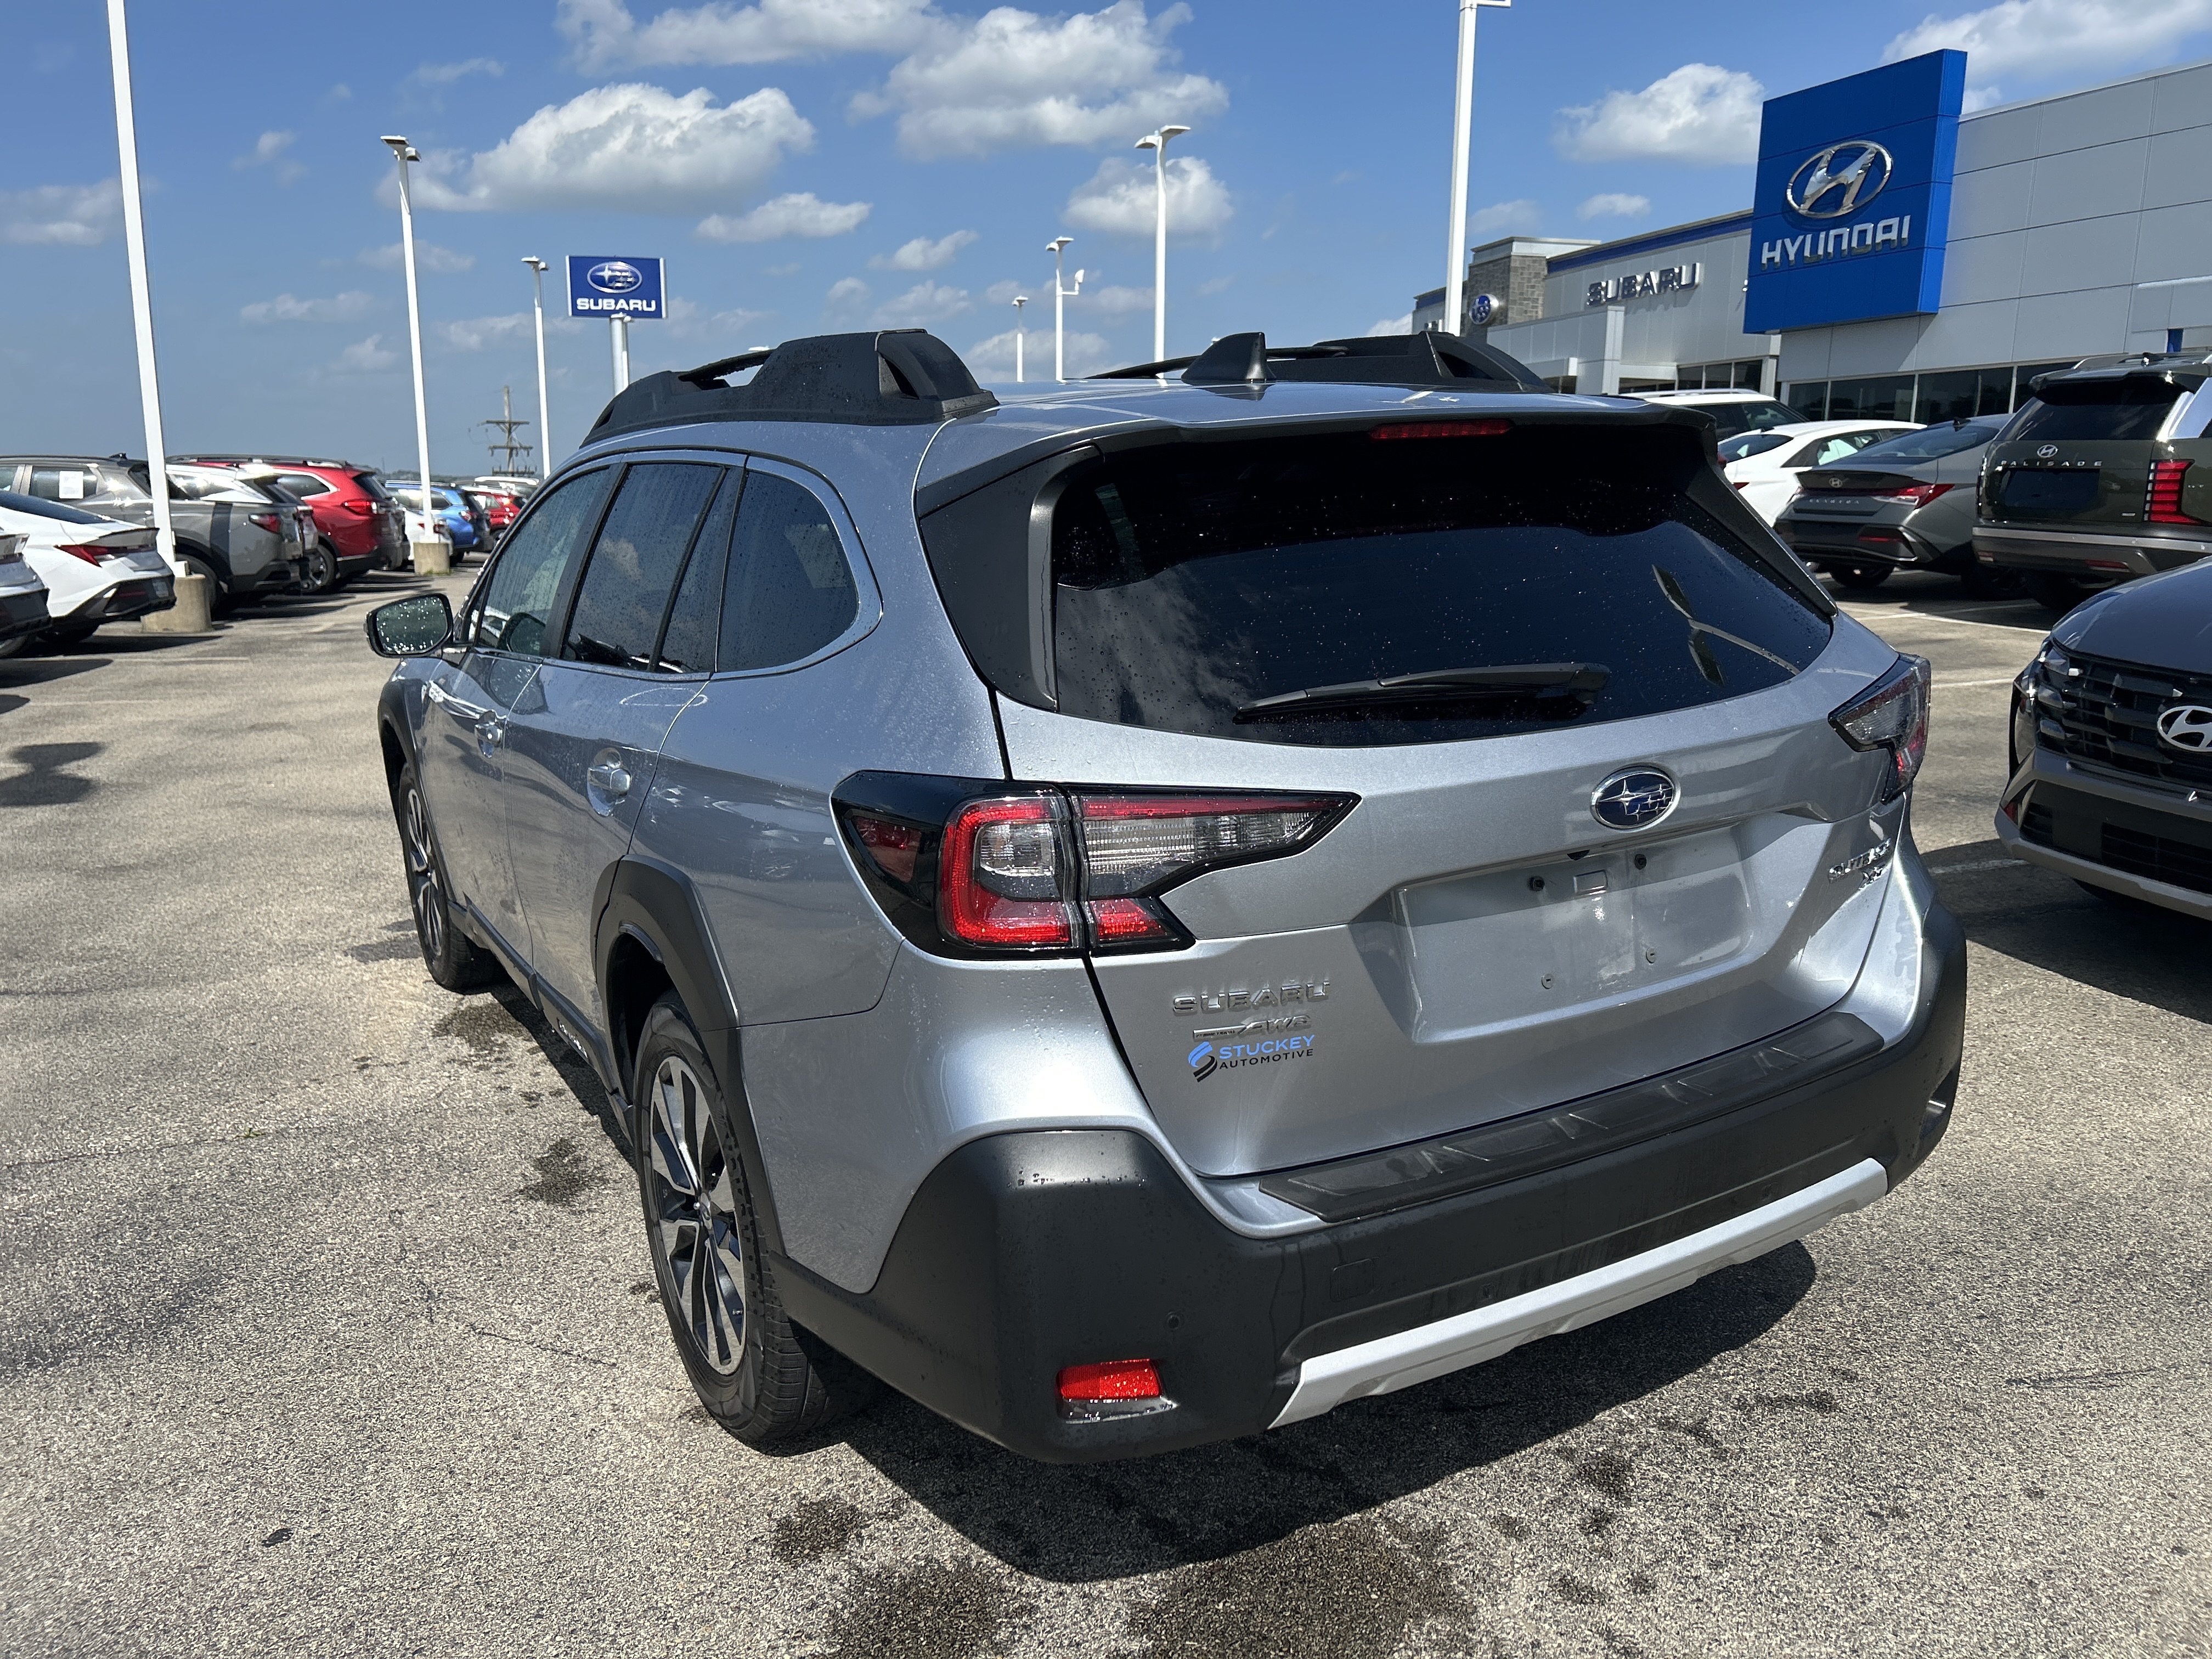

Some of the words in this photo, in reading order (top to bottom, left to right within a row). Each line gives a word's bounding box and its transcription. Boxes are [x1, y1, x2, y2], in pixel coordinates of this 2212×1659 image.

[1761, 215, 1911, 270] HYUNDAI
[1587, 262, 1701, 305] SUBARU
[577, 298, 656, 312] SUBARU
[1172, 980, 1330, 1015] SUBARU
[1219, 1035, 1315, 1060] STUCKEY
[1219, 1048, 1314, 1070] AUTOMOTIVE
